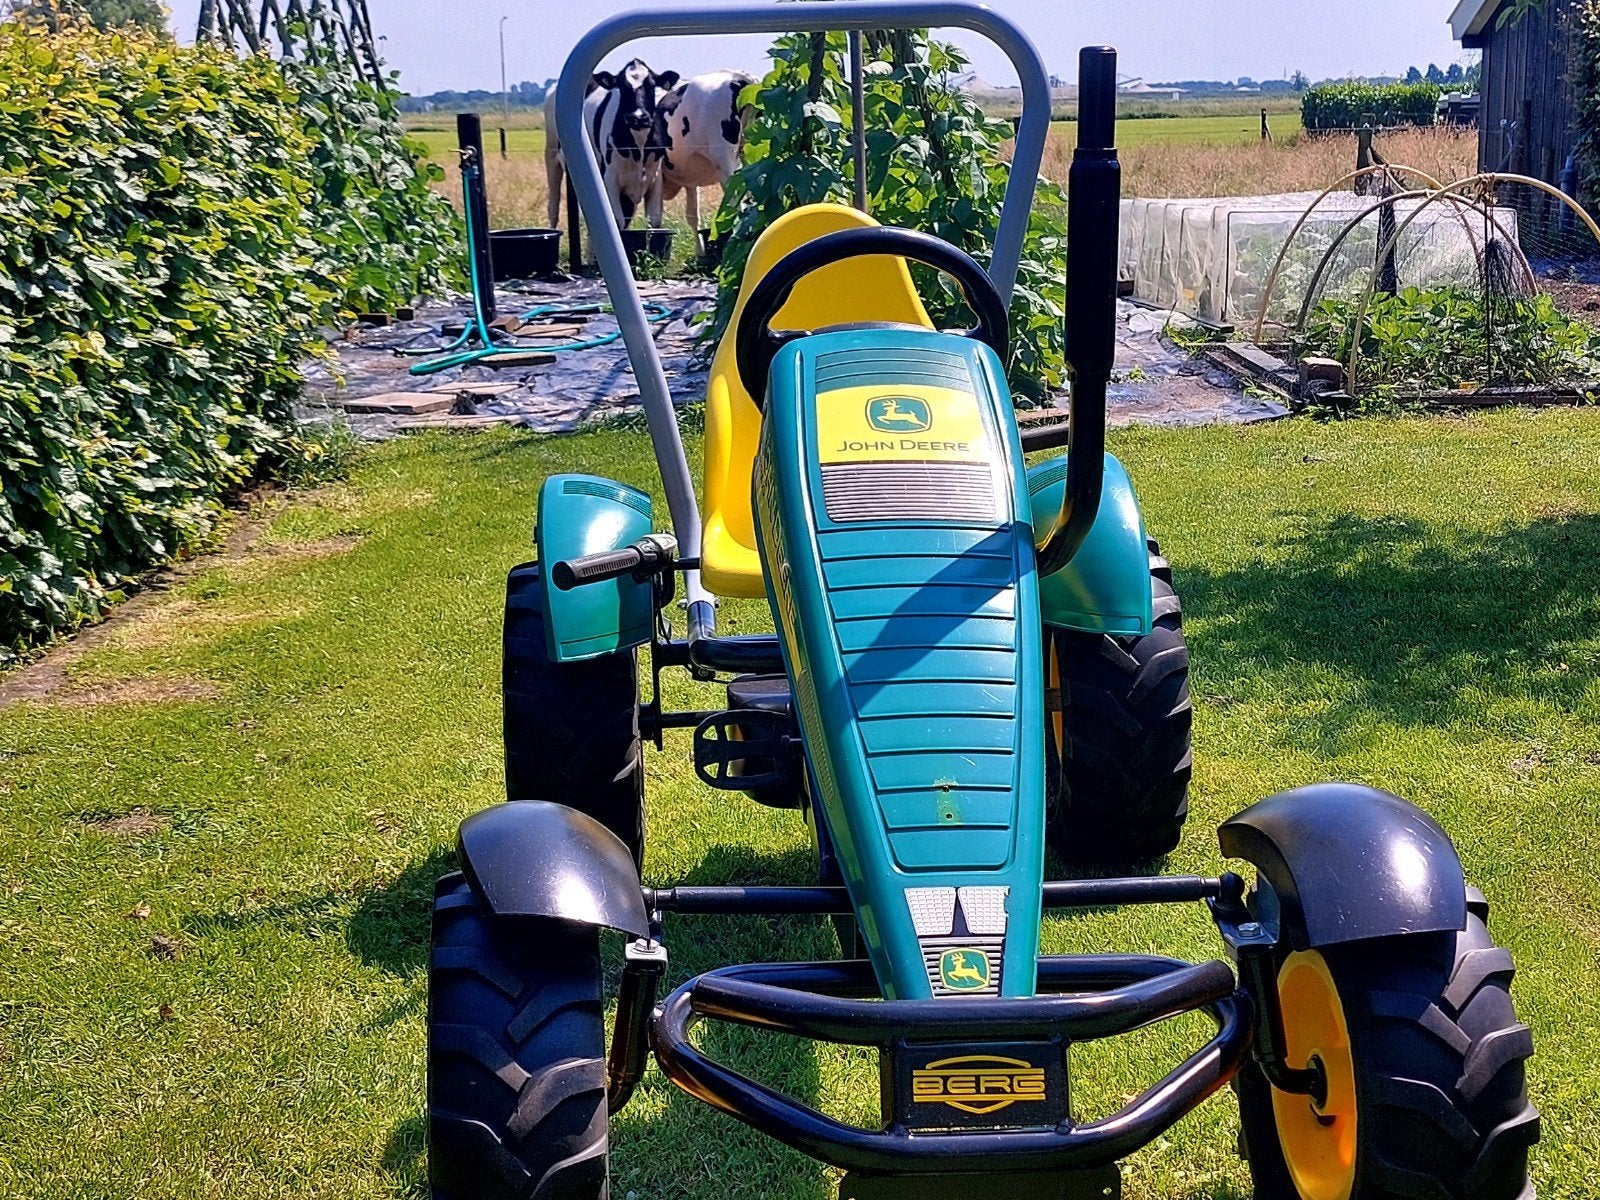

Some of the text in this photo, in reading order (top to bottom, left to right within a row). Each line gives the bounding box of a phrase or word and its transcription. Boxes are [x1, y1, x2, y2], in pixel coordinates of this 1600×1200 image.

[836, 439, 971, 453] JOHN DEERE
[912, 1074, 1046, 1095] BERG
